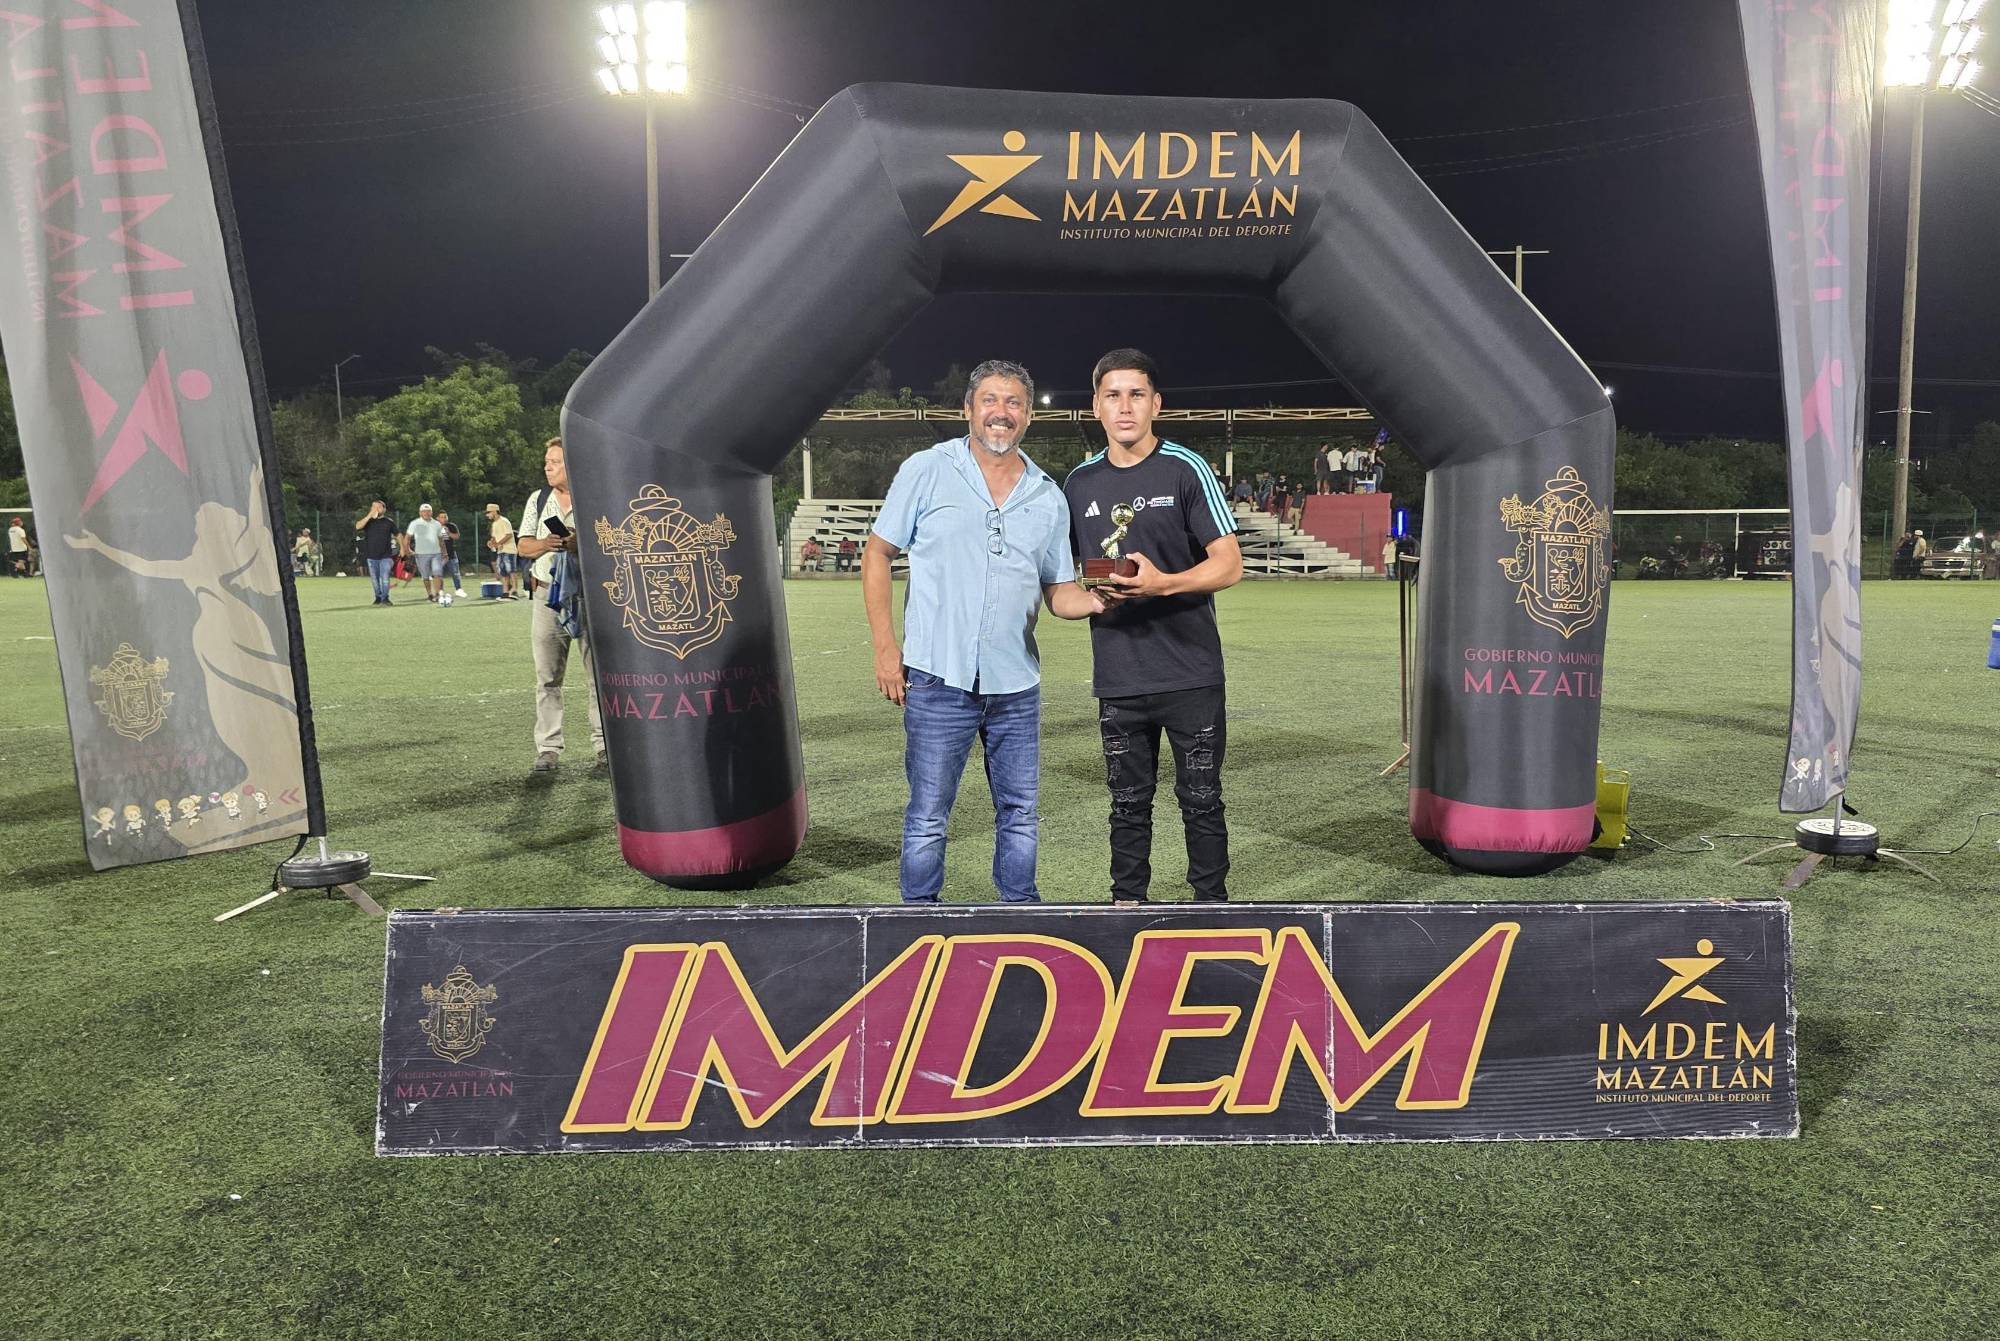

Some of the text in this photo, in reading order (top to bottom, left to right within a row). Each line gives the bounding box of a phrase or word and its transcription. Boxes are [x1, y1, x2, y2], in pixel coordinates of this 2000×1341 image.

[1067, 130, 1300, 180] IMDEM
[1062, 179, 1298, 222] MAZATLÁN
[1060, 224, 1292, 240] INSTITUTO MUNICIPAL DEL DEPORTE
[1541, 534, 1591, 545] MAZATLAN
[634, 553, 697, 564] MAZATLAN
[1552, 602, 1582, 611] MAZATL
[659, 623, 695, 632] MAZATL
[1464, 649, 1553, 664] GOBIERNO
[1464, 666, 1601, 698] MAZATL
[561, 922, 1520, 1133] IMDEM
[1598, 1022, 1775, 1060] IMDEM
[1596, 1060, 1773, 1089] MAZATLÁN
[395, 1081, 513, 1098] MAZATLAN
[1596, 1093, 1772, 1103] INSTITUTO MUNICIPAL DEL DEPORTE
